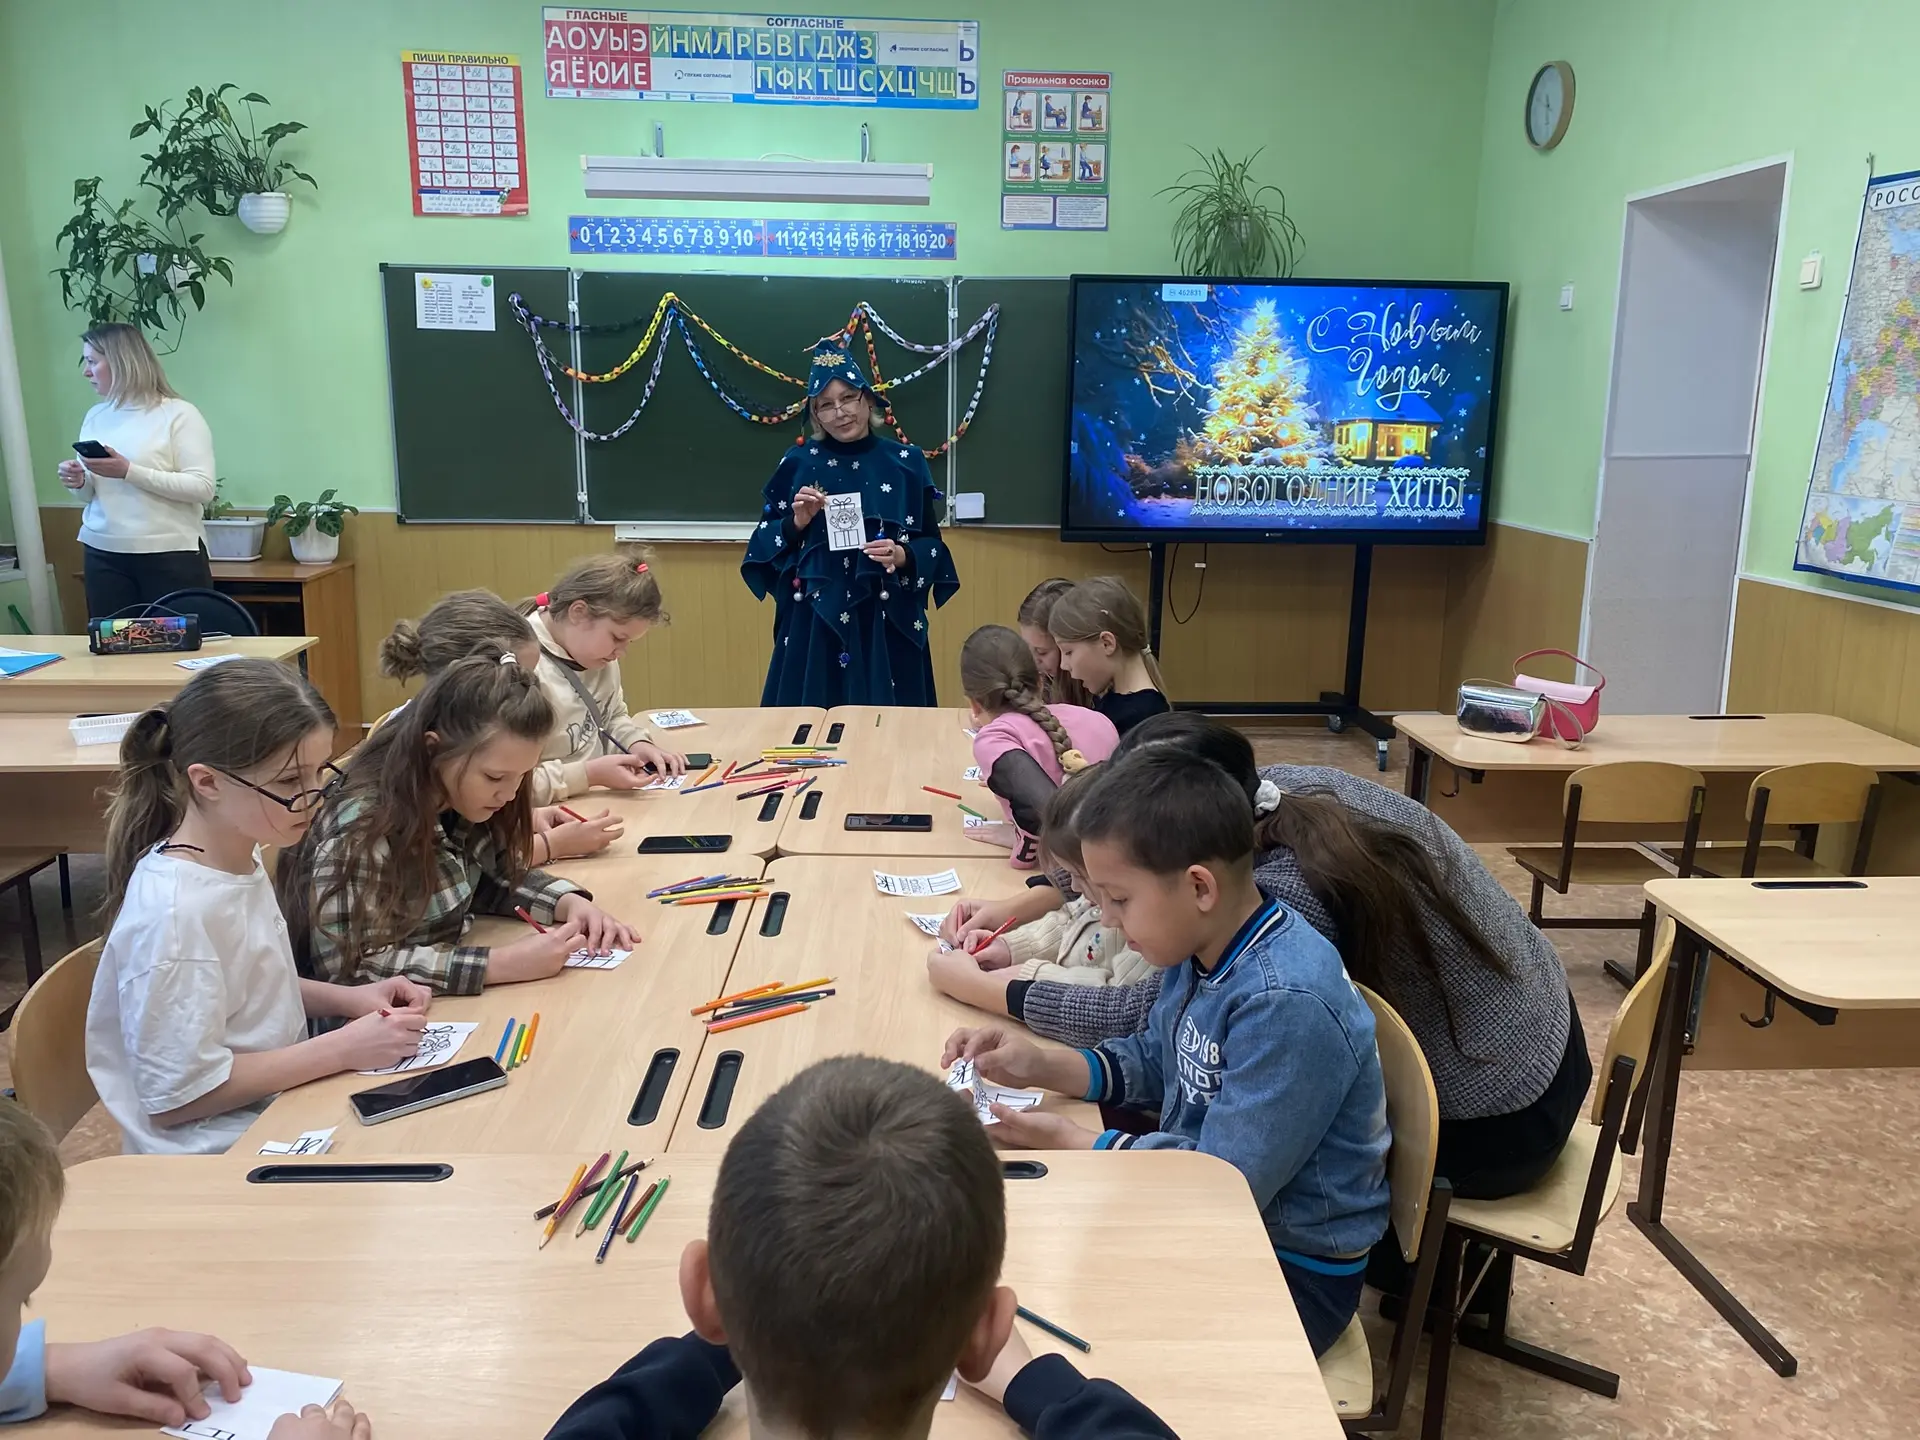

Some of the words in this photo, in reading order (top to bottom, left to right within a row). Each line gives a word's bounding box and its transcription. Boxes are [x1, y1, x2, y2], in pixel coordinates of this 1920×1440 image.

[566, 10, 628, 22] ГЛАСНЫЕ
[766, 17, 844, 29] СОГЛАСНЫЕ
[413, 53, 445, 63] ПИШИ
[448, 55, 509, 64] ПРАВИЛЬНО
[1007, 74, 1066, 86] Правильная
[1070, 78, 1107, 86] осанка
[1875, 186, 1920, 206] РОСС
[580, 226, 590, 244] 0
[595, 226, 603, 244] 1
[610, 227, 621, 244] 2
[626, 227, 636, 244] 3
[641, 227, 652, 244] 4
[658, 228, 668, 244] 5
[673, 228, 683, 245] 6
[688, 228, 698, 245] 7
[704, 229, 713, 246] 8
[719, 229, 729, 246] 9
[735, 229, 753, 246] 10
[776, 230, 788, 246] 11
[791, 230, 807, 246] 12
[809, 231, 824, 247] 13
[826, 231, 842, 248] 14
[844, 232, 859, 248] 15
[861, 232, 876, 248] 16
[878, 232, 893, 248] 17
[895, 232, 911, 248] 18
[913, 233, 927, 249] 19
[930, 233, 946, 249] 20
[1347, 302, 1482, 352] Новым
[1348, 346, 1451, 412] Годом
[1194, 474, 1378, 508] НОВОГОДНИЕ
[1386, 475, 1466, 510] ХИТЫ
